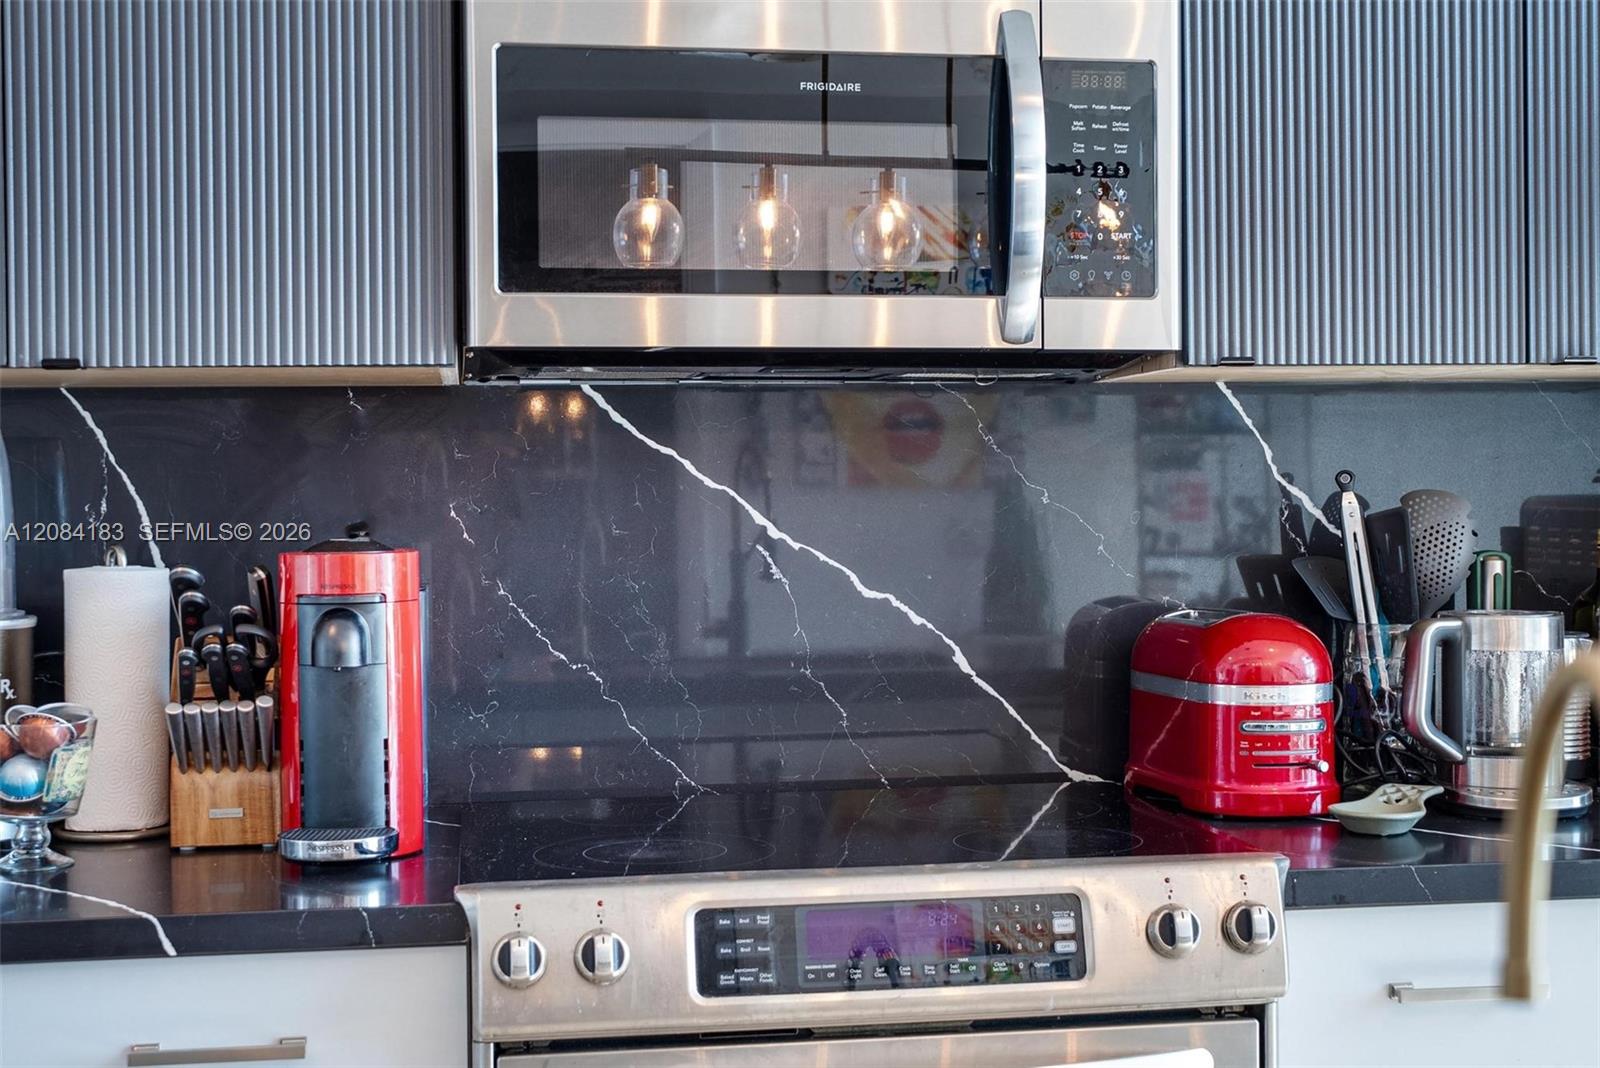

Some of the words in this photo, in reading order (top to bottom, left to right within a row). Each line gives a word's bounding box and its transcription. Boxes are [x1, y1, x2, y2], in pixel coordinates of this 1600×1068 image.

[800, 82, 861, 91] FRIGIDAIRE
[1076, 165, 1081, 173] 1
[1097, 165, 1103, 173] 2
[1118, 166, 1124, 174] 3
[1076, 187, 1082, 195] 4
[1097, 188, 1103, 196] 5
[1076, 210, 1082, 218] 7
[1118, 211, 1124, 219] 9
[1097, 232, 1103, 241] 0
[1110, 232, 1133, 240] START
[1014, 904, 1020, 912] 2
[1034, 903, 1041, 912] 3
[1015, 923, 1021, 931] 5
[1016, 942, 1022, 950] 8
[1038, 941, 1044, 949] 9
[1018, 961, 1024, 969] 0
